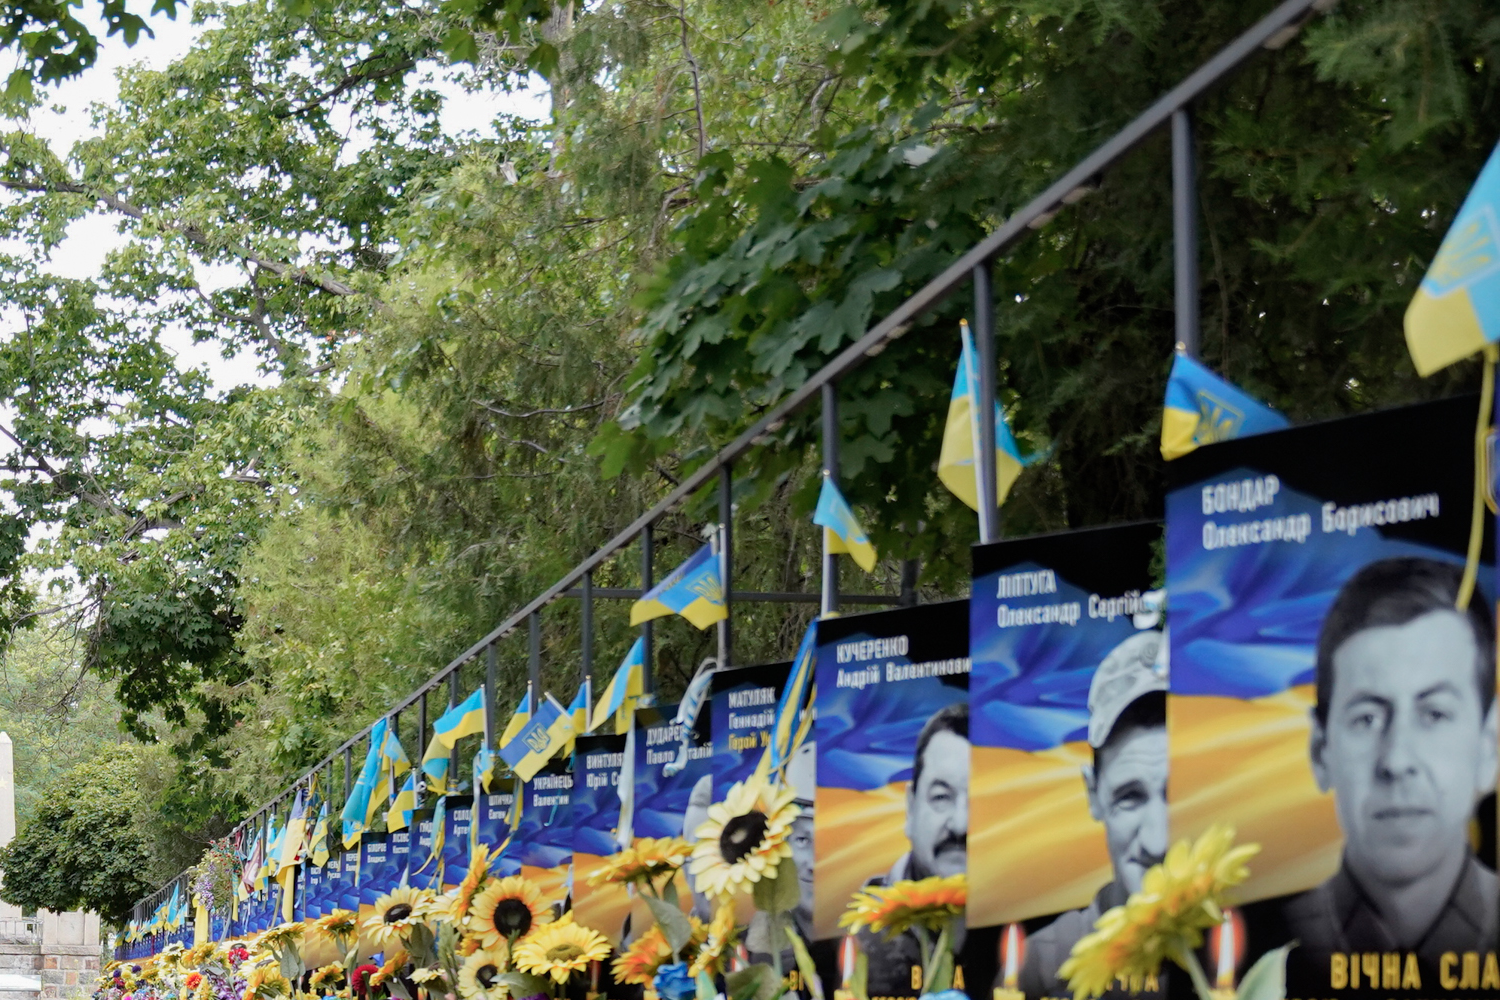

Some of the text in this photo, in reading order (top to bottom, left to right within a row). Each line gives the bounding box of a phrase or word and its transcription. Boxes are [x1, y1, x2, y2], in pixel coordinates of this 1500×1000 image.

[1202, 474, 1279, 515] БОНДАР
[1202, 492, 1439, 550] Олександр Борисович
[997, 568, 1057, 599] ЛІПТУГА
[997, 600, 1081, 628] Олександр
[836, 634, 909, 664] КУЧЕРЕНКО
[836, 663, 880, 690] Андрій
[728, 708, 775, 730] Геннадій
[646, 750, 675, 765] Павло
[533, 773, 573, 790] УКРАЇНЕЦЬ
[586, 772, 608, 791] Юрій
[1330, 951, 1500, 991] ВІЧНА СЛА
